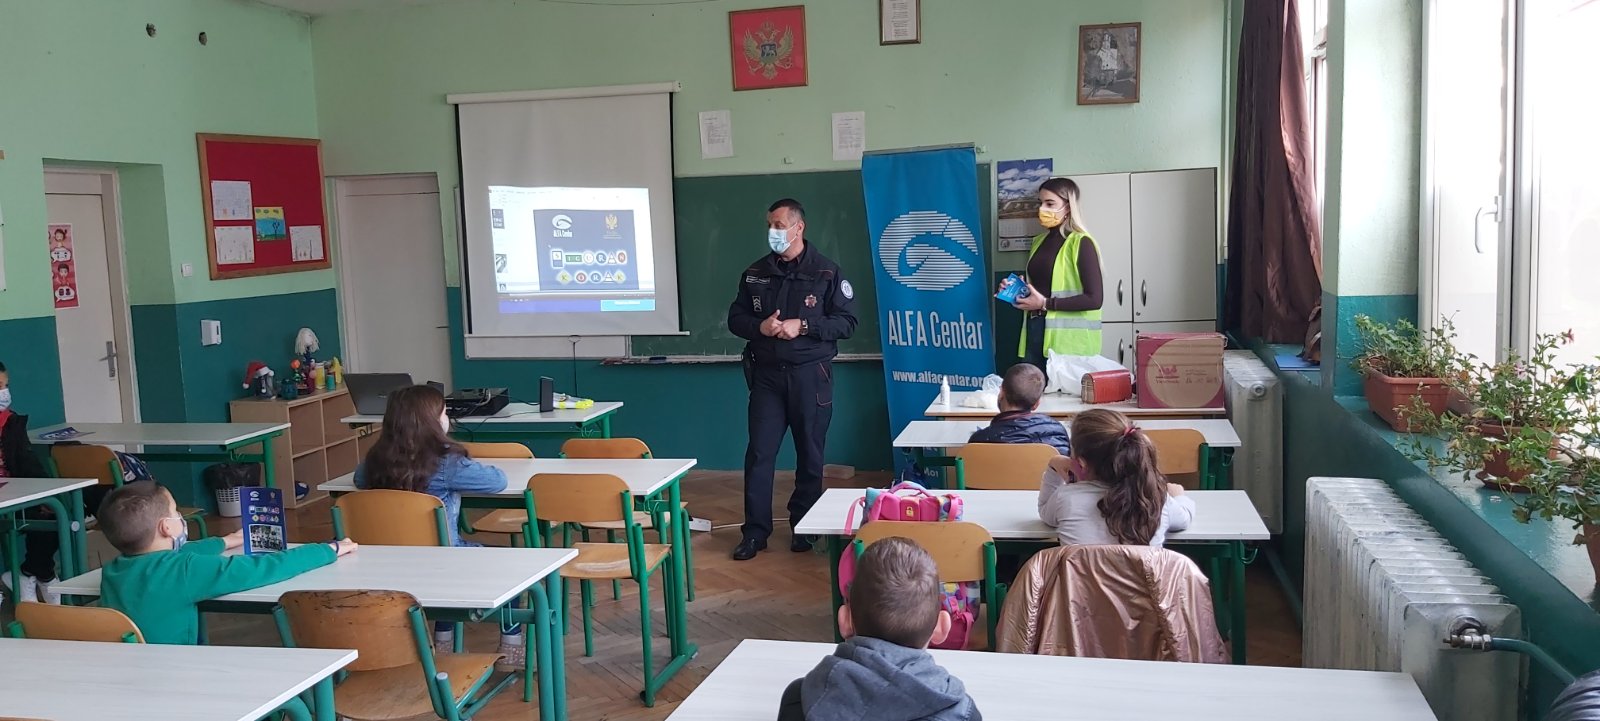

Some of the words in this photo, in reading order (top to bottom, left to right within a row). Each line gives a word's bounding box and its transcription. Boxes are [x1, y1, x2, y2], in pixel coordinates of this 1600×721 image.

[888, 310, 928, 347] ALFA
[929, 311, 983, 350] Centar
[892, 370, 984, 388] www.alfacntar.or
